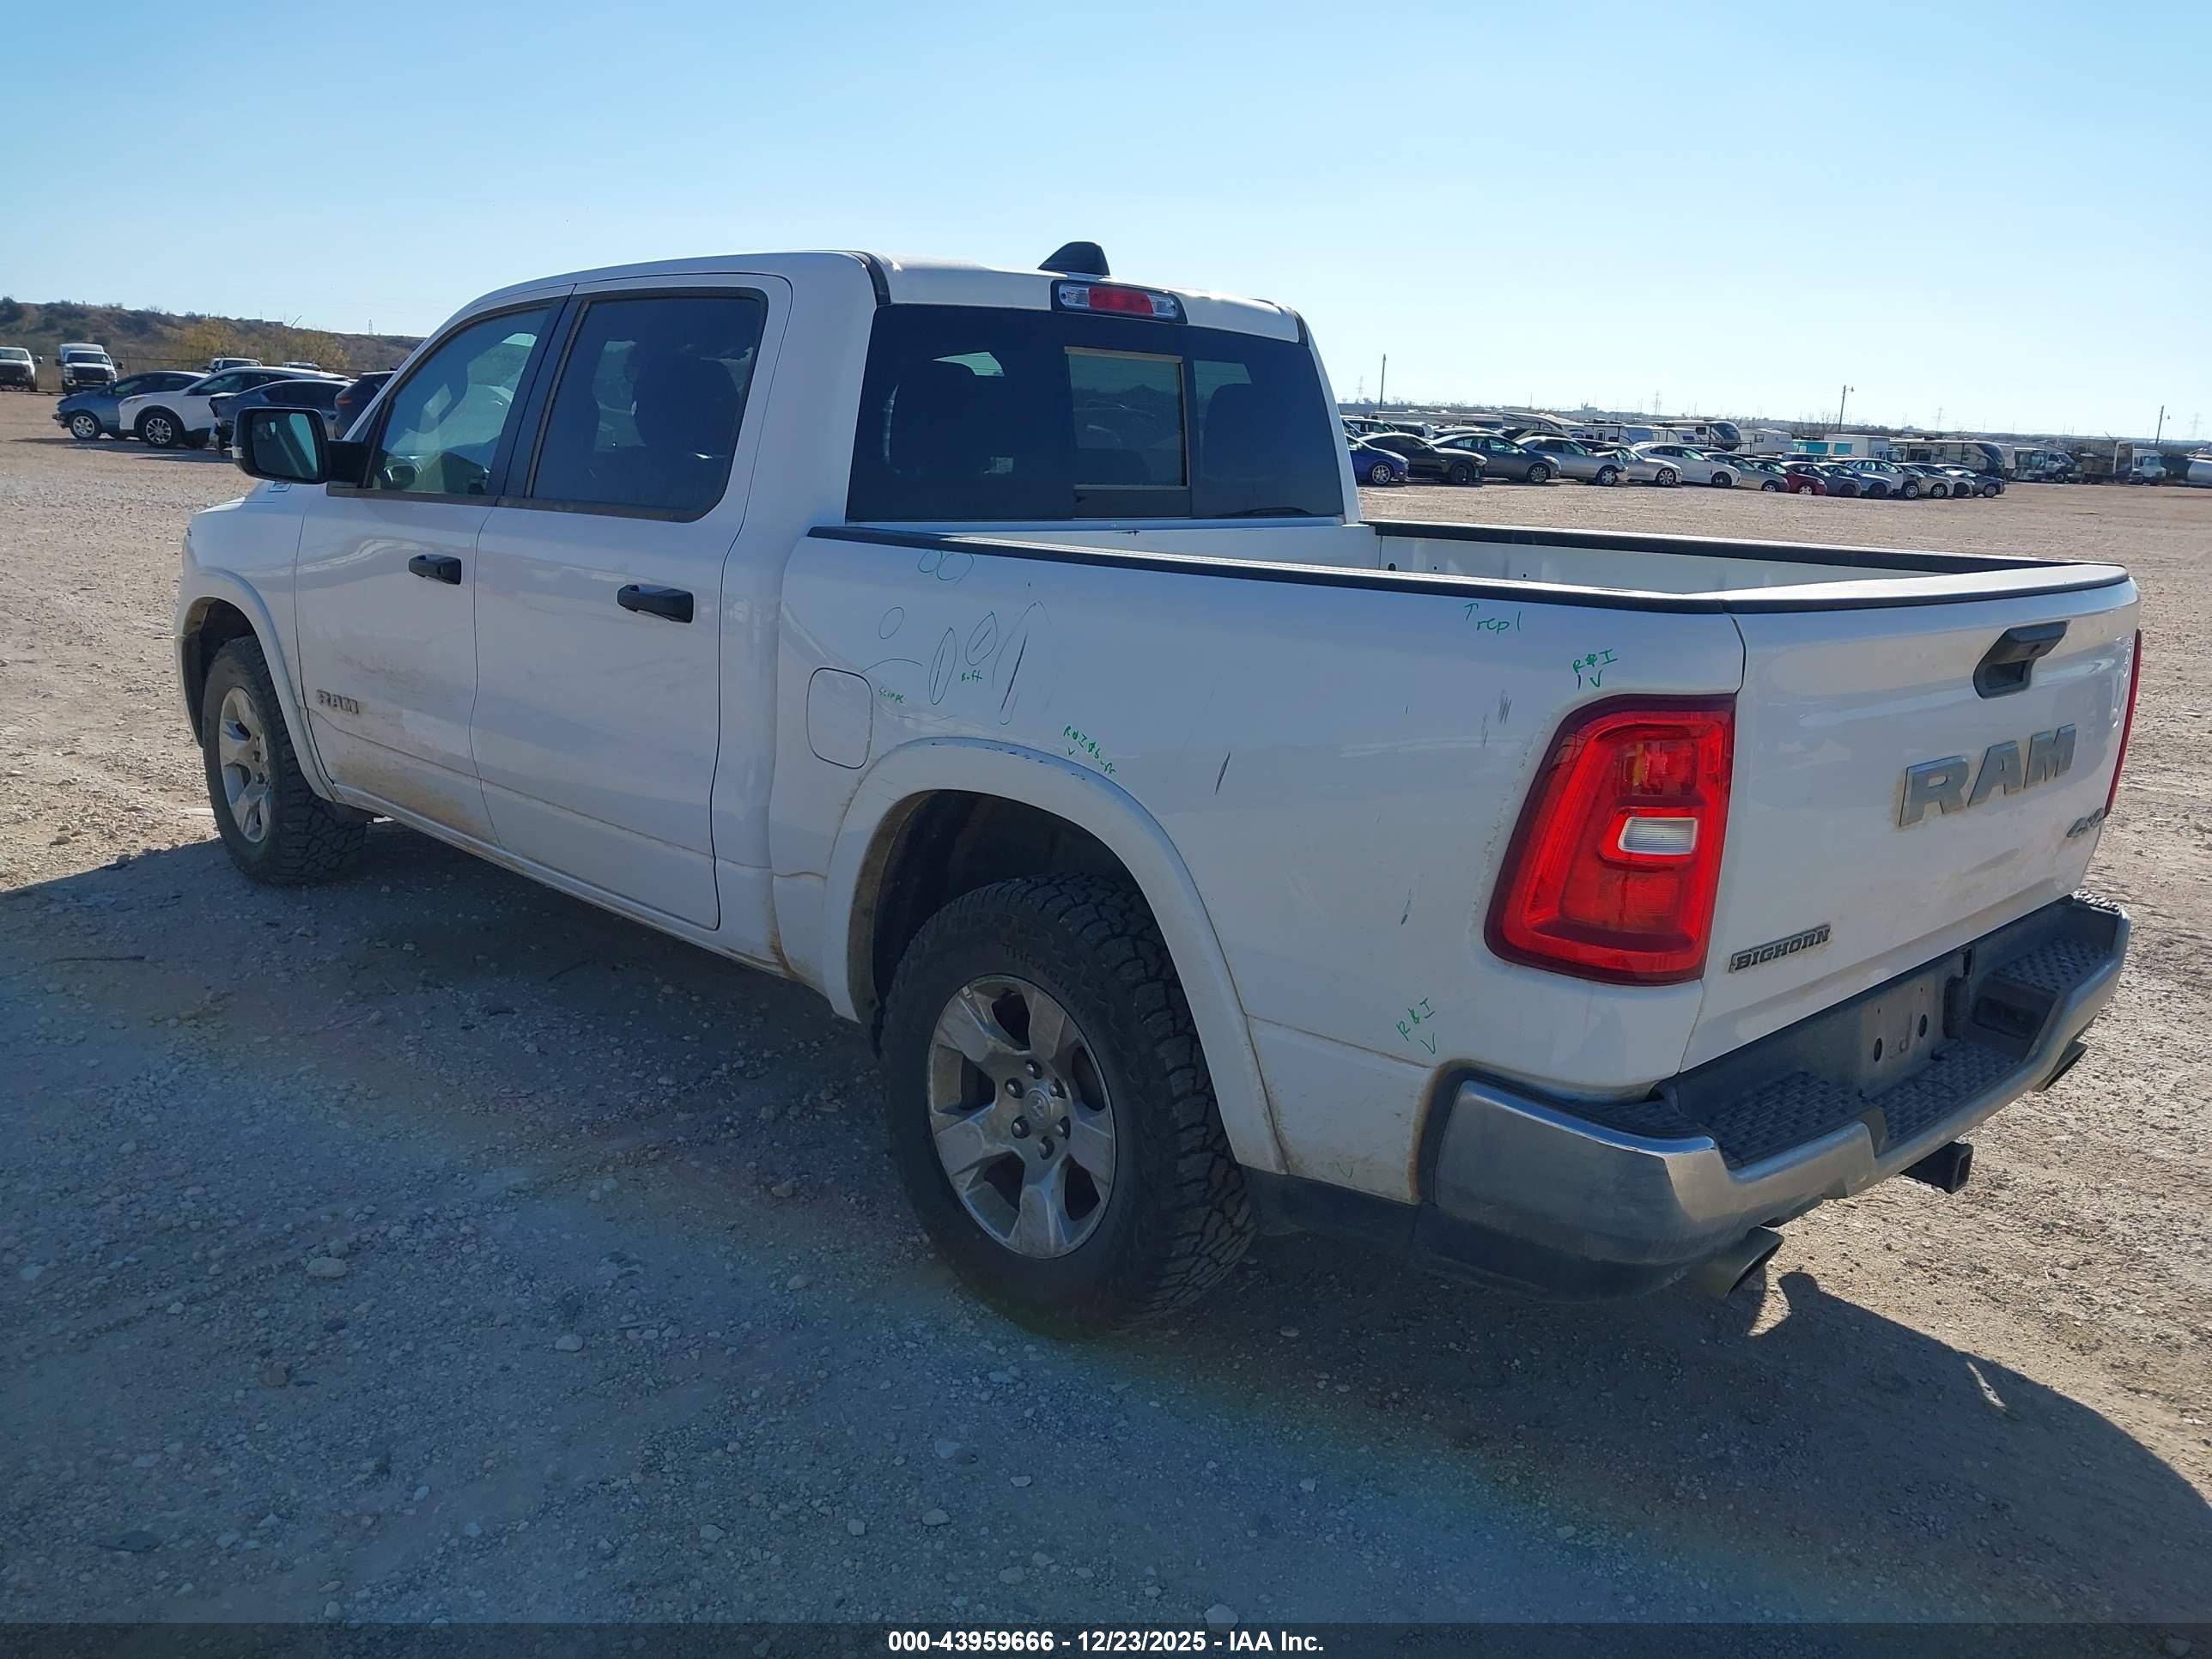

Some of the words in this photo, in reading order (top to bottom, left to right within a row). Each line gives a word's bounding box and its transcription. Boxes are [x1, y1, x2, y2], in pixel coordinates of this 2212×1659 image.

[316, 689, 359, 714] RAM
[1898, 722, 2078, 828] RAM
[1729, 923, 1831, 974] BIGHORN
